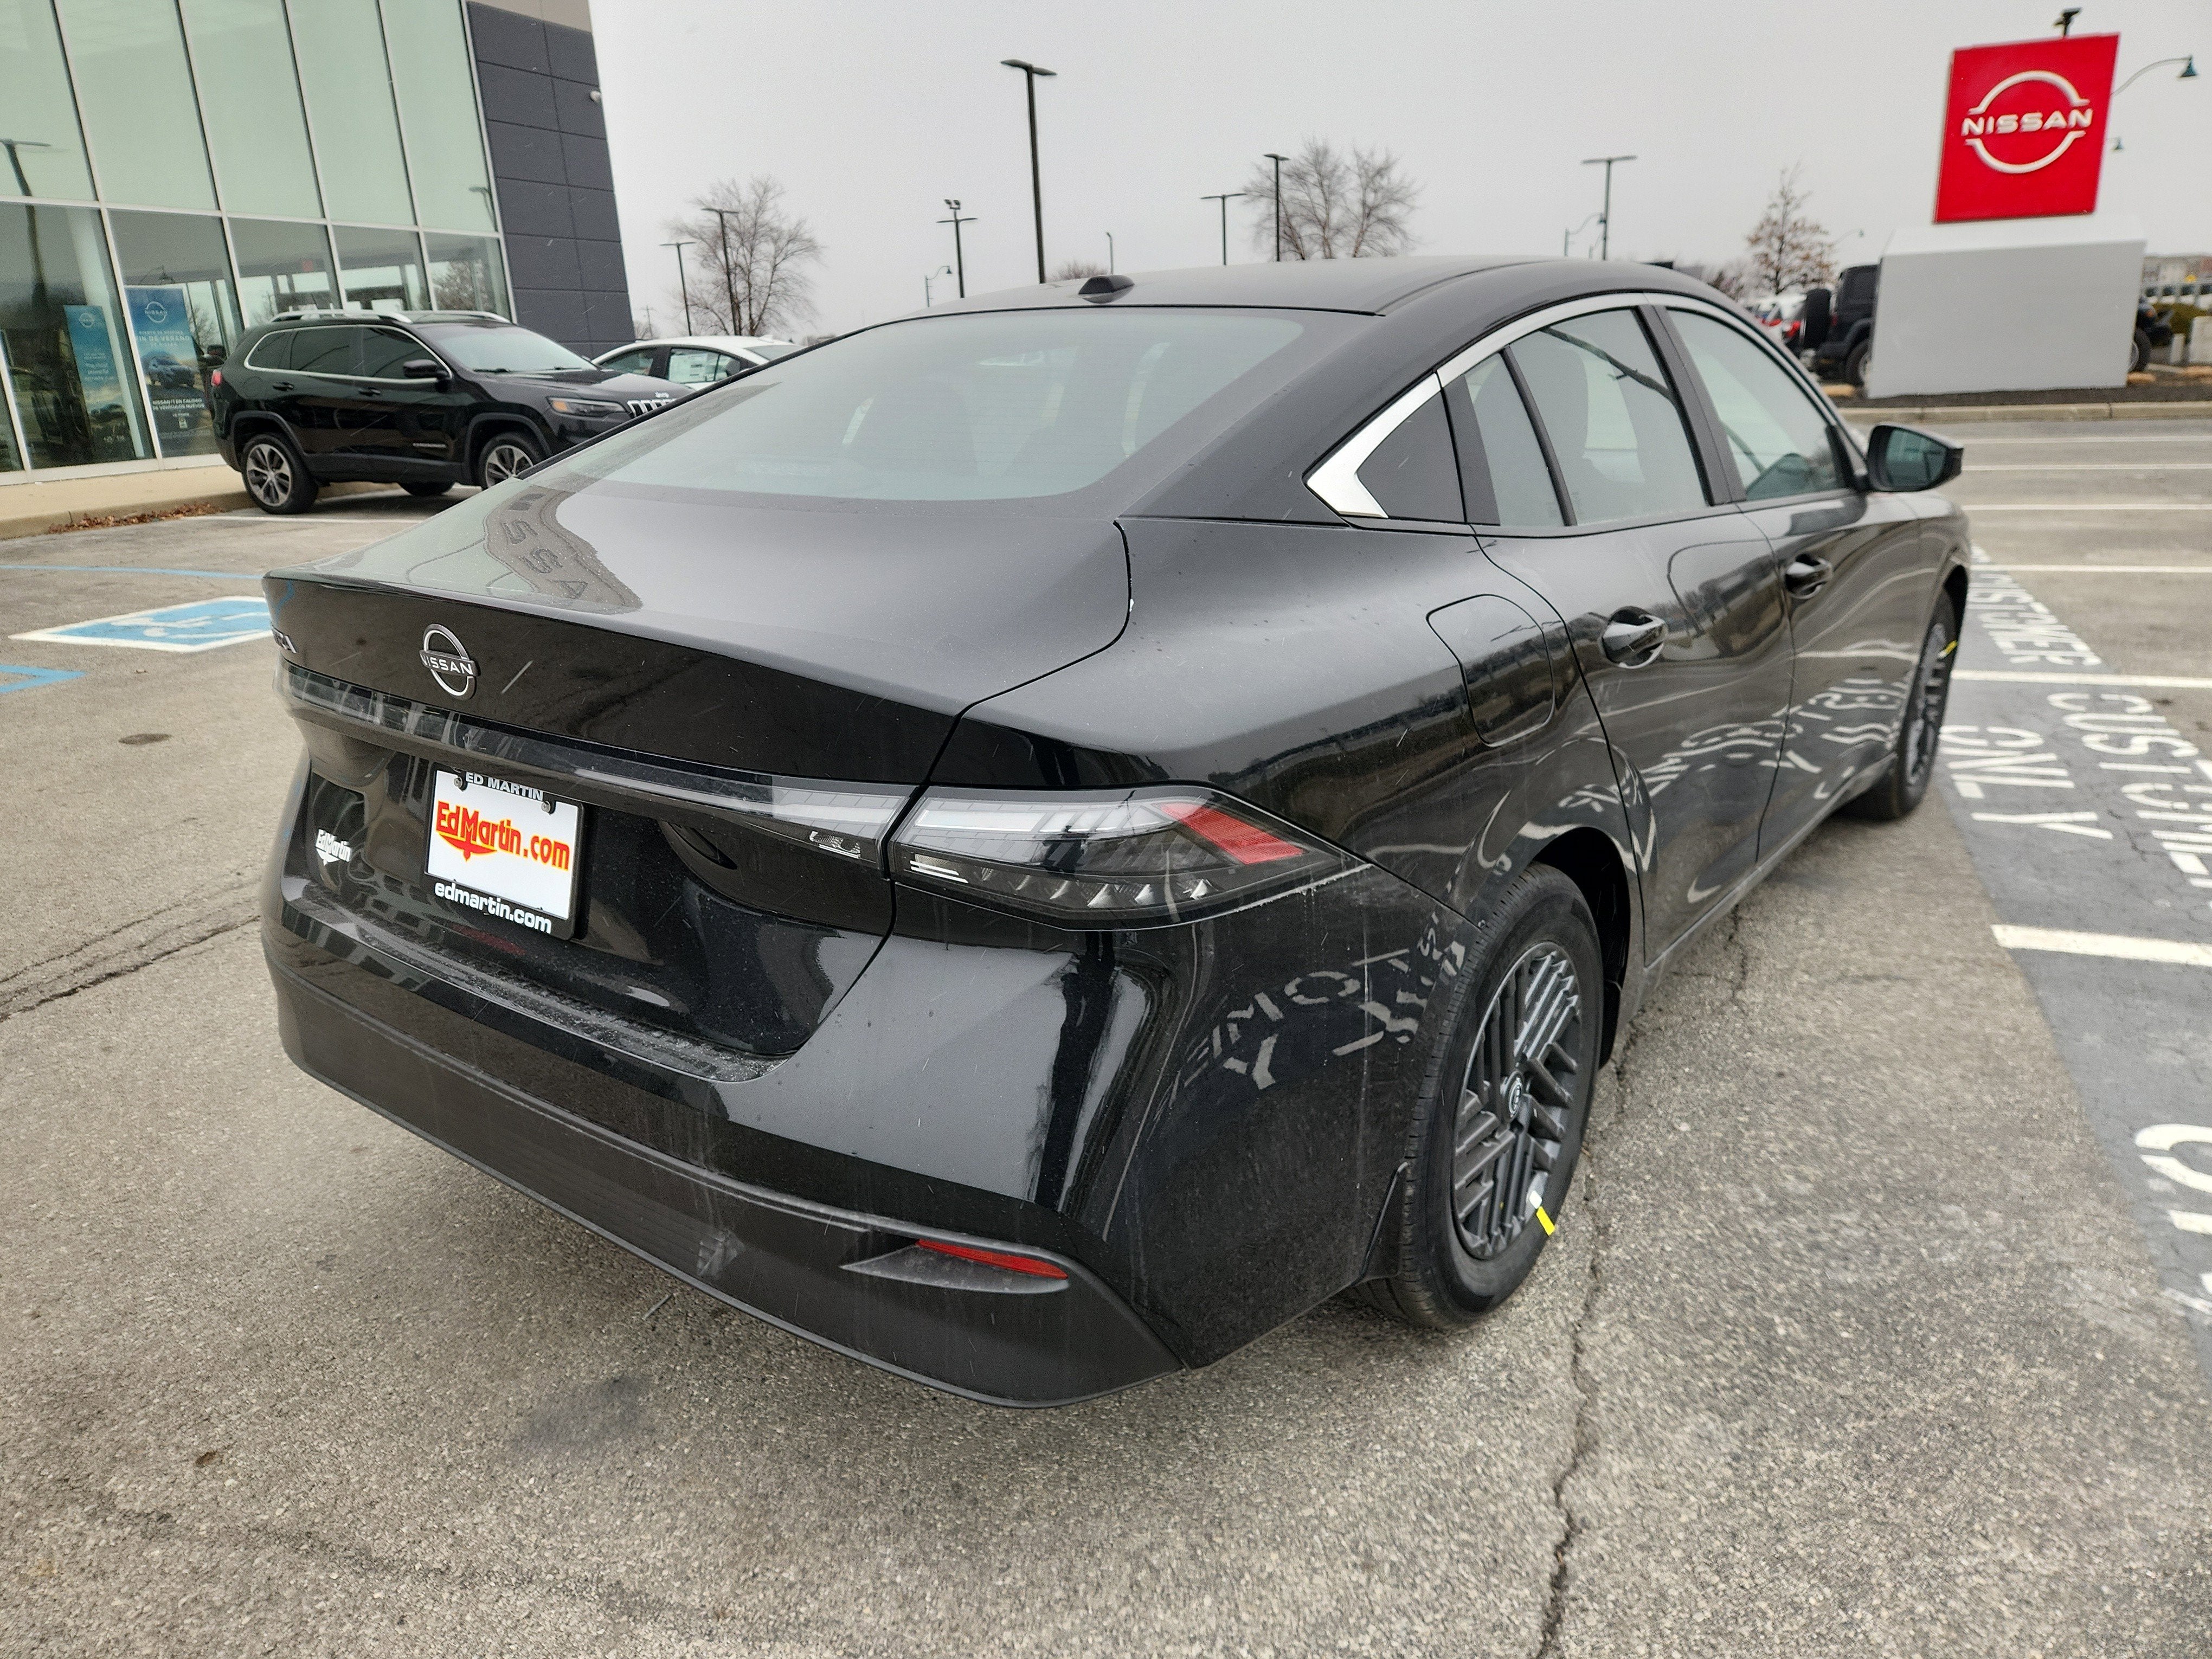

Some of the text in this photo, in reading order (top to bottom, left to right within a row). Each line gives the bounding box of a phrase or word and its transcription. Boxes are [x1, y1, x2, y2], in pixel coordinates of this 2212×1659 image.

[1961, 108, 2093, 136] NISSAN
[420, 654, 473, 675] NISSAN
[465, 772, 543, 801] ED MARTIN
[1939, 725, 2113, 839] ONLY
[316, 828, 352, 863] EdMartin
[435, 882, 551, 934] edmartin.com
